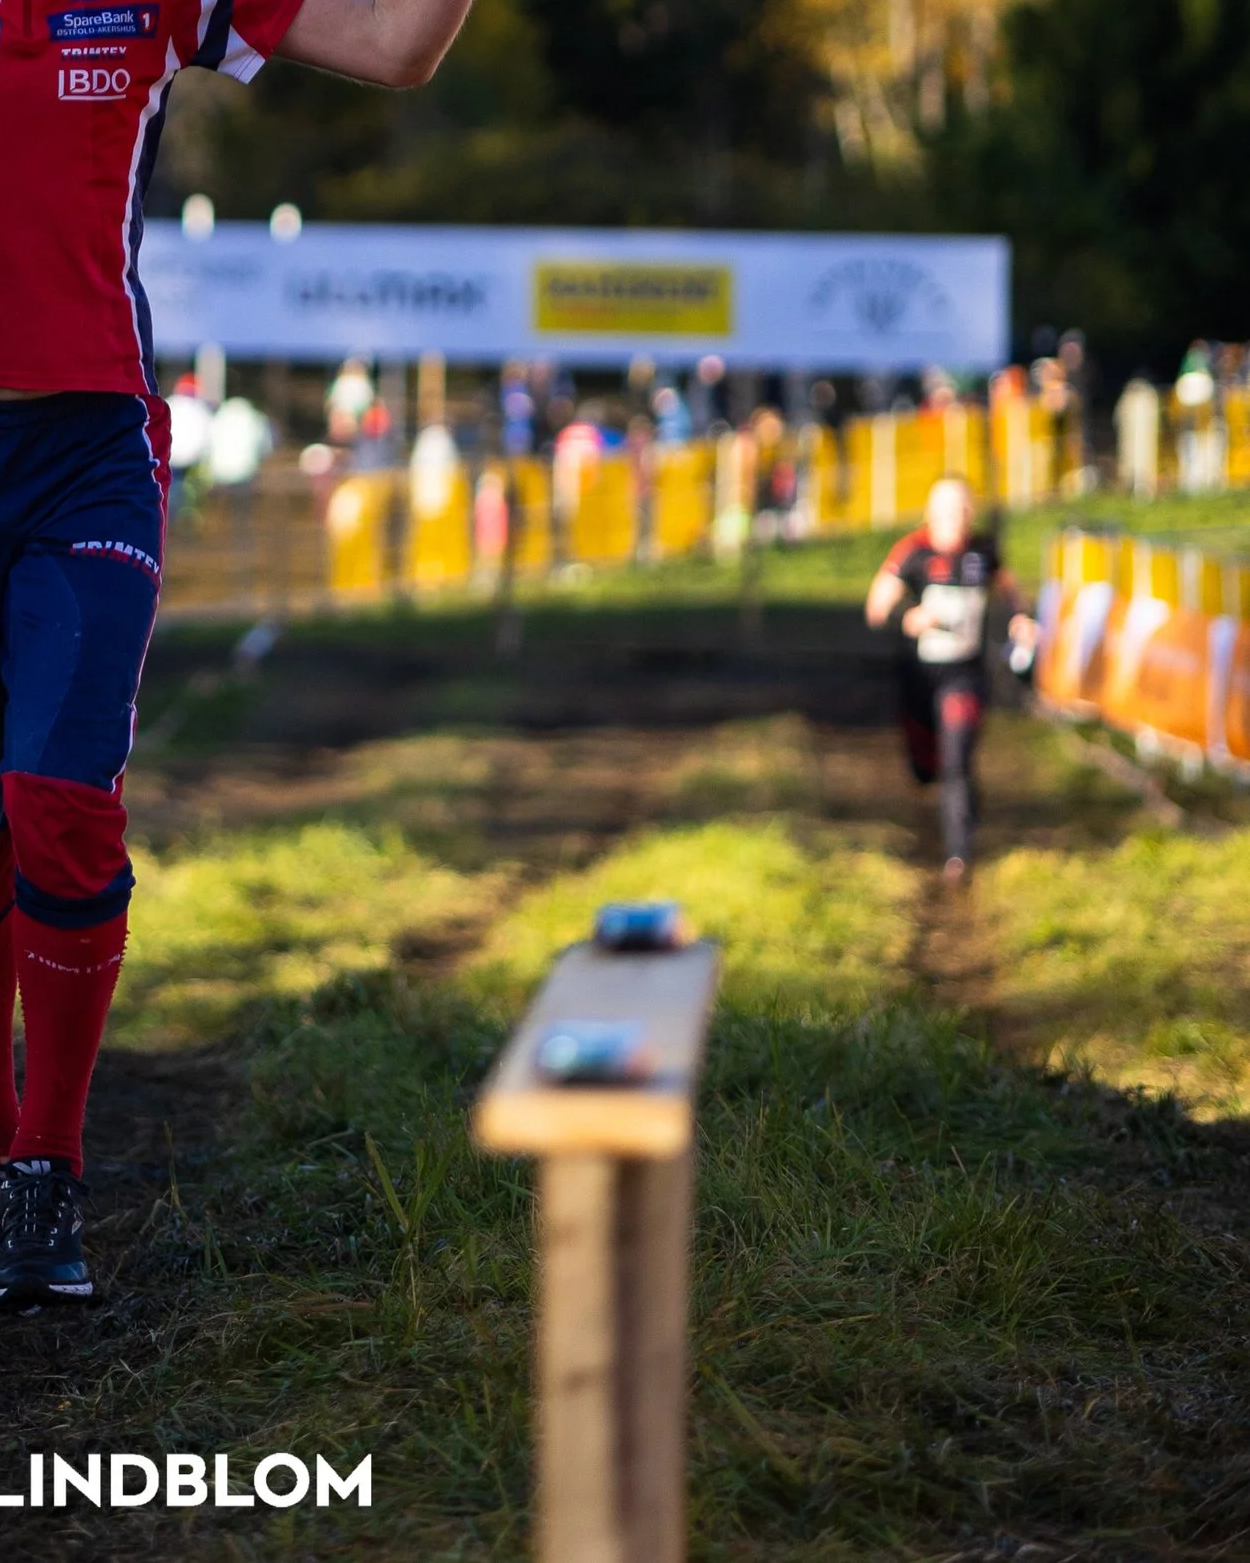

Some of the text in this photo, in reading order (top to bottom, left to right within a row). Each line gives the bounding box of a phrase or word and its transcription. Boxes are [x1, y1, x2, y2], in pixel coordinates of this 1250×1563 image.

[63, 9, 150, 29] SpareBank 1
[69, 68, 130, 94] BDO
